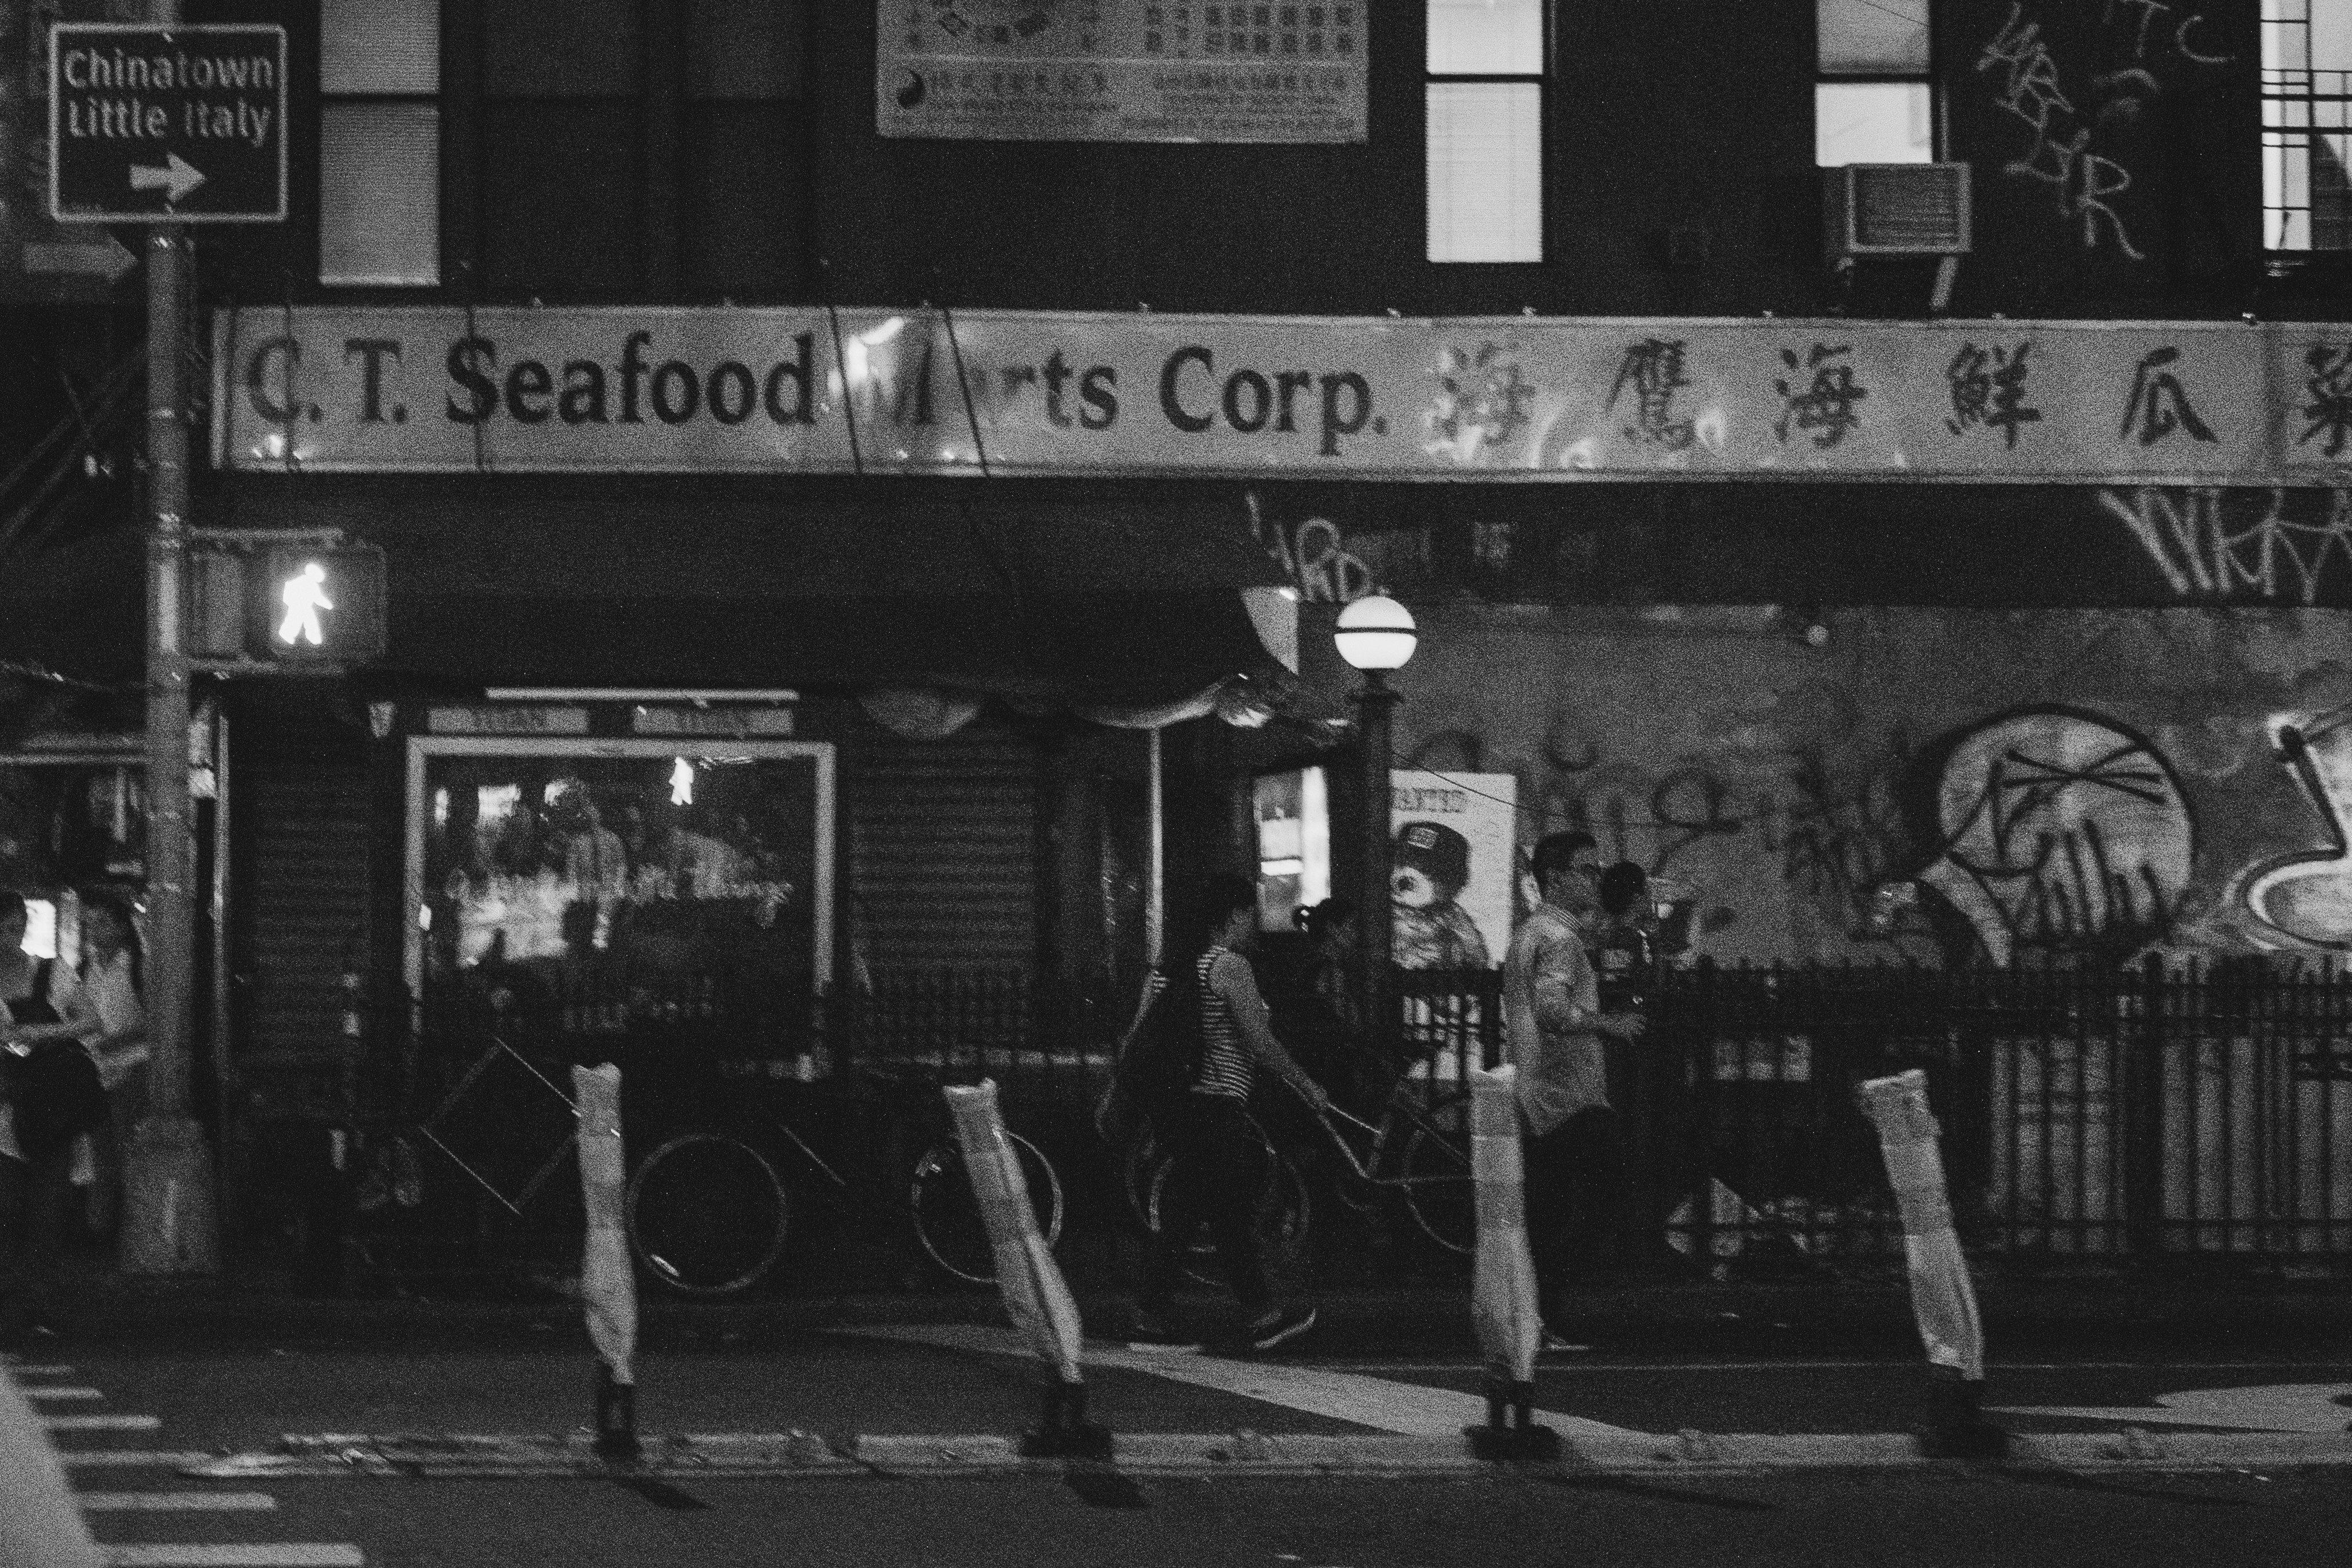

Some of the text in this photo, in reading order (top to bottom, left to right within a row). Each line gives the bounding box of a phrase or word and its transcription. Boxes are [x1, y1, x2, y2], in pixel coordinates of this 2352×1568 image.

[64, 47, 273, 89] Chinatown
[68, 95, 271, 149] Little Italy
[446, 330, 817, 427] Seafood
[1159, 344, 1390, 456] Corp.
